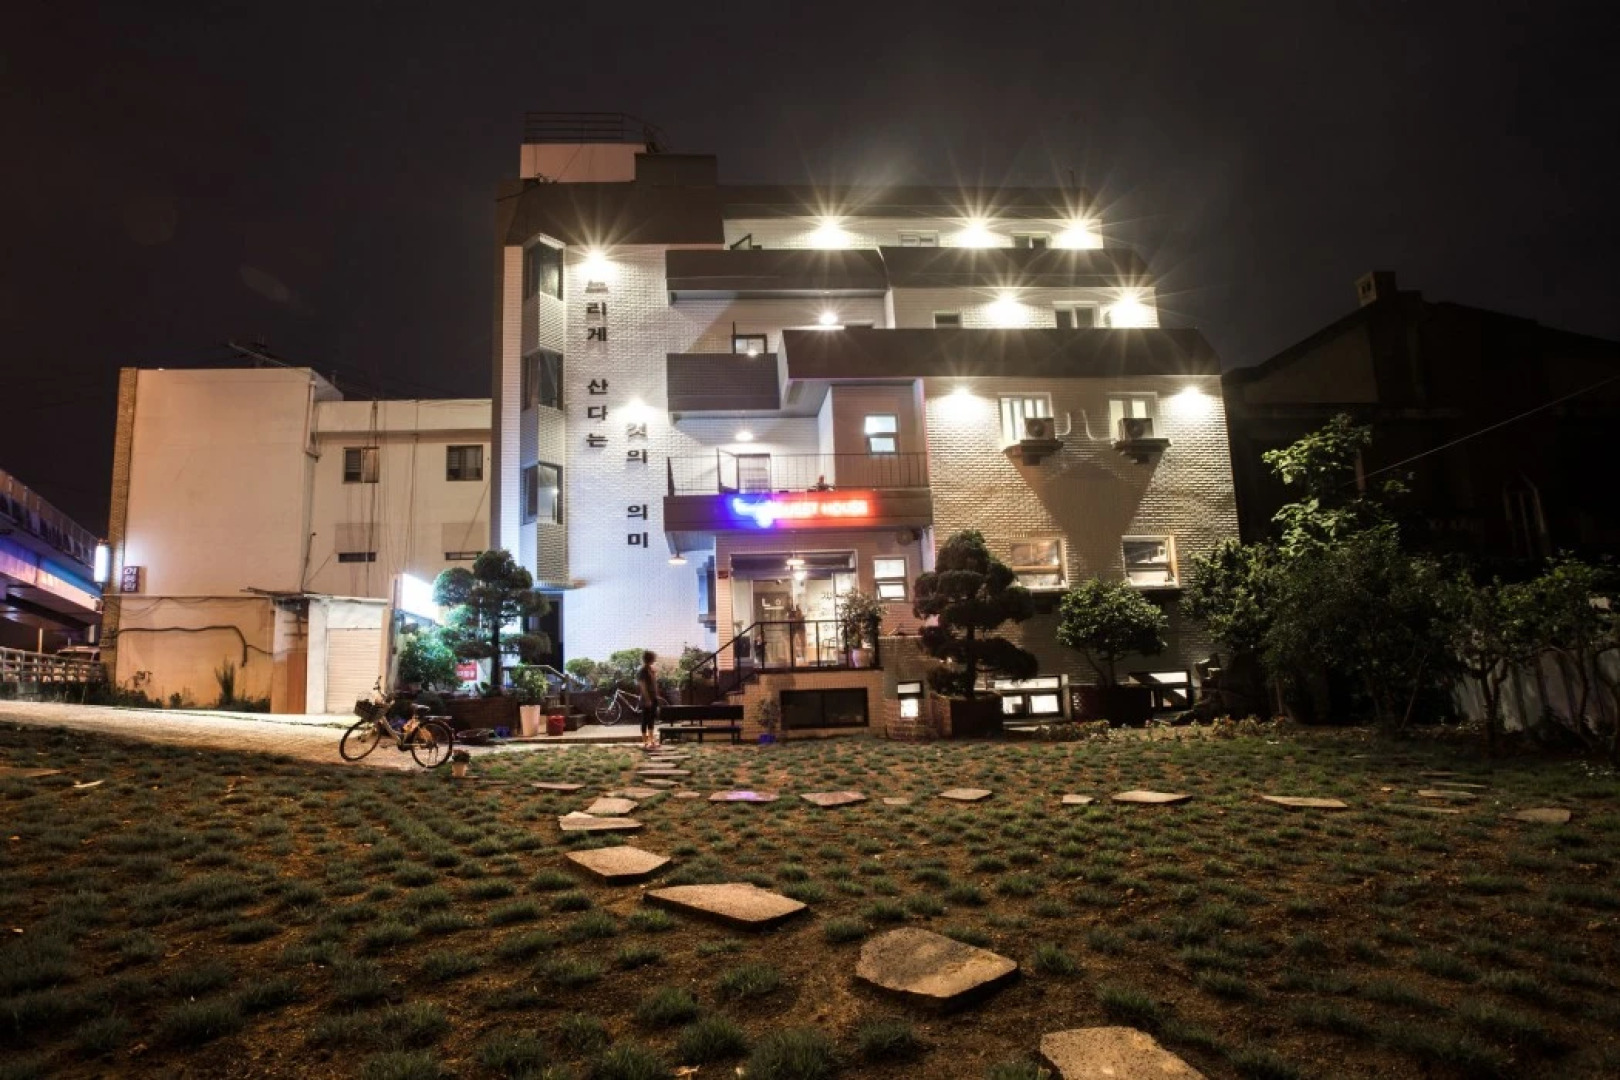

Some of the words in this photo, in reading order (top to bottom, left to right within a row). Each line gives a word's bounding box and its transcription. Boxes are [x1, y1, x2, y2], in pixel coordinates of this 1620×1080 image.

[586, 378, 608, 448] 산다는
[626, 422, 648, 464] 것의
[627, 504, 648, 548] 의미
